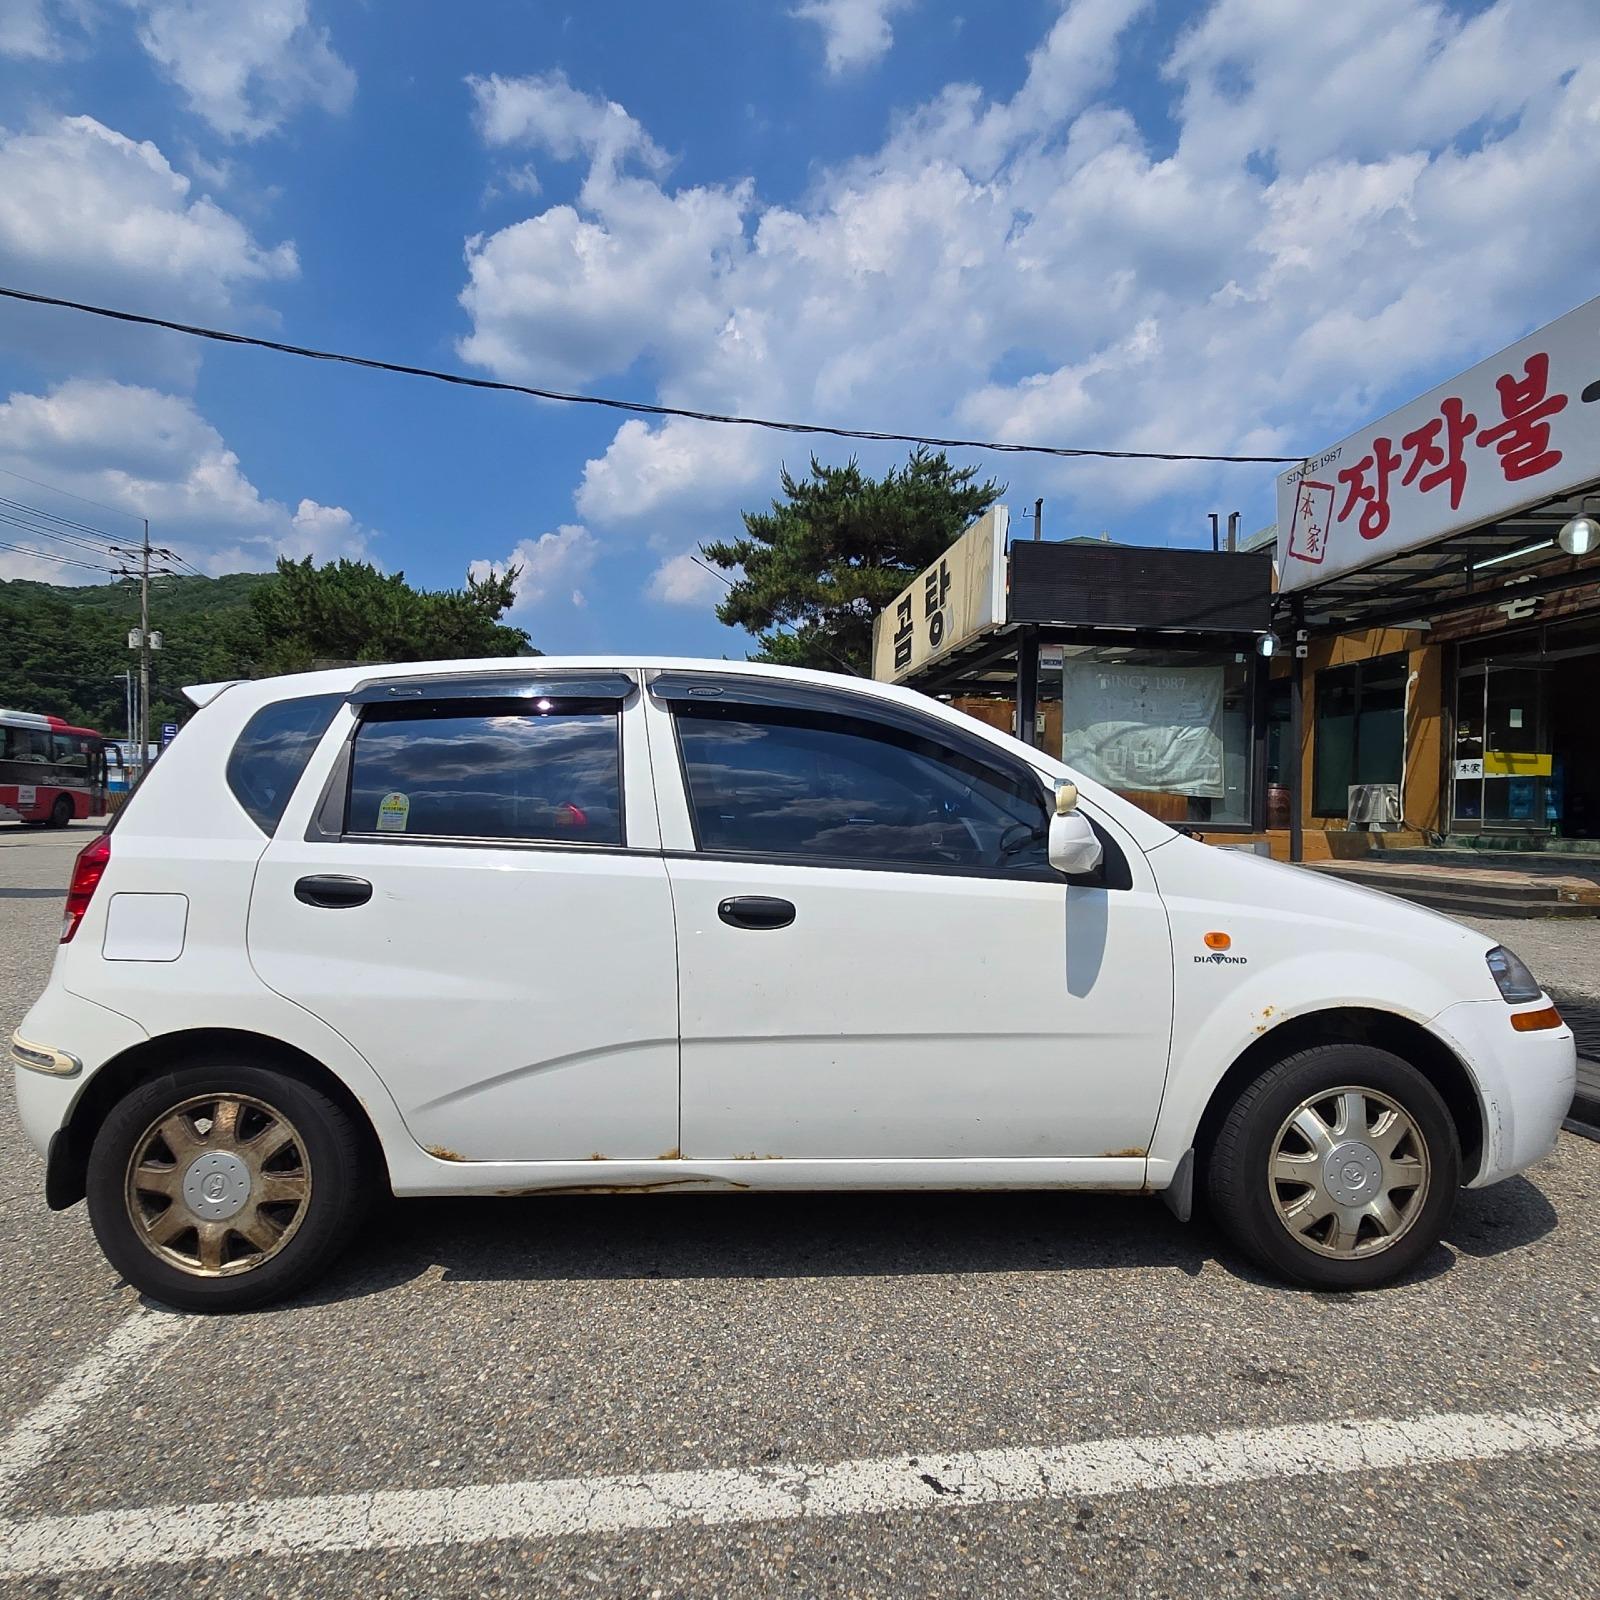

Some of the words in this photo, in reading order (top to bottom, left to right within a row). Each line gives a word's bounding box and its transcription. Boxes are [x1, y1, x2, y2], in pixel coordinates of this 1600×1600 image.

[1286, 460, 1319, 485] SINCE
[1320, 447, 1342, 468] 1987
[1337, 352, 1569, 540] 장작불
[1300, 492, 1321, 553] 本家
[894, 558, 951, 672] 곰탕
[1155, 677, 1186, 690] 1987
